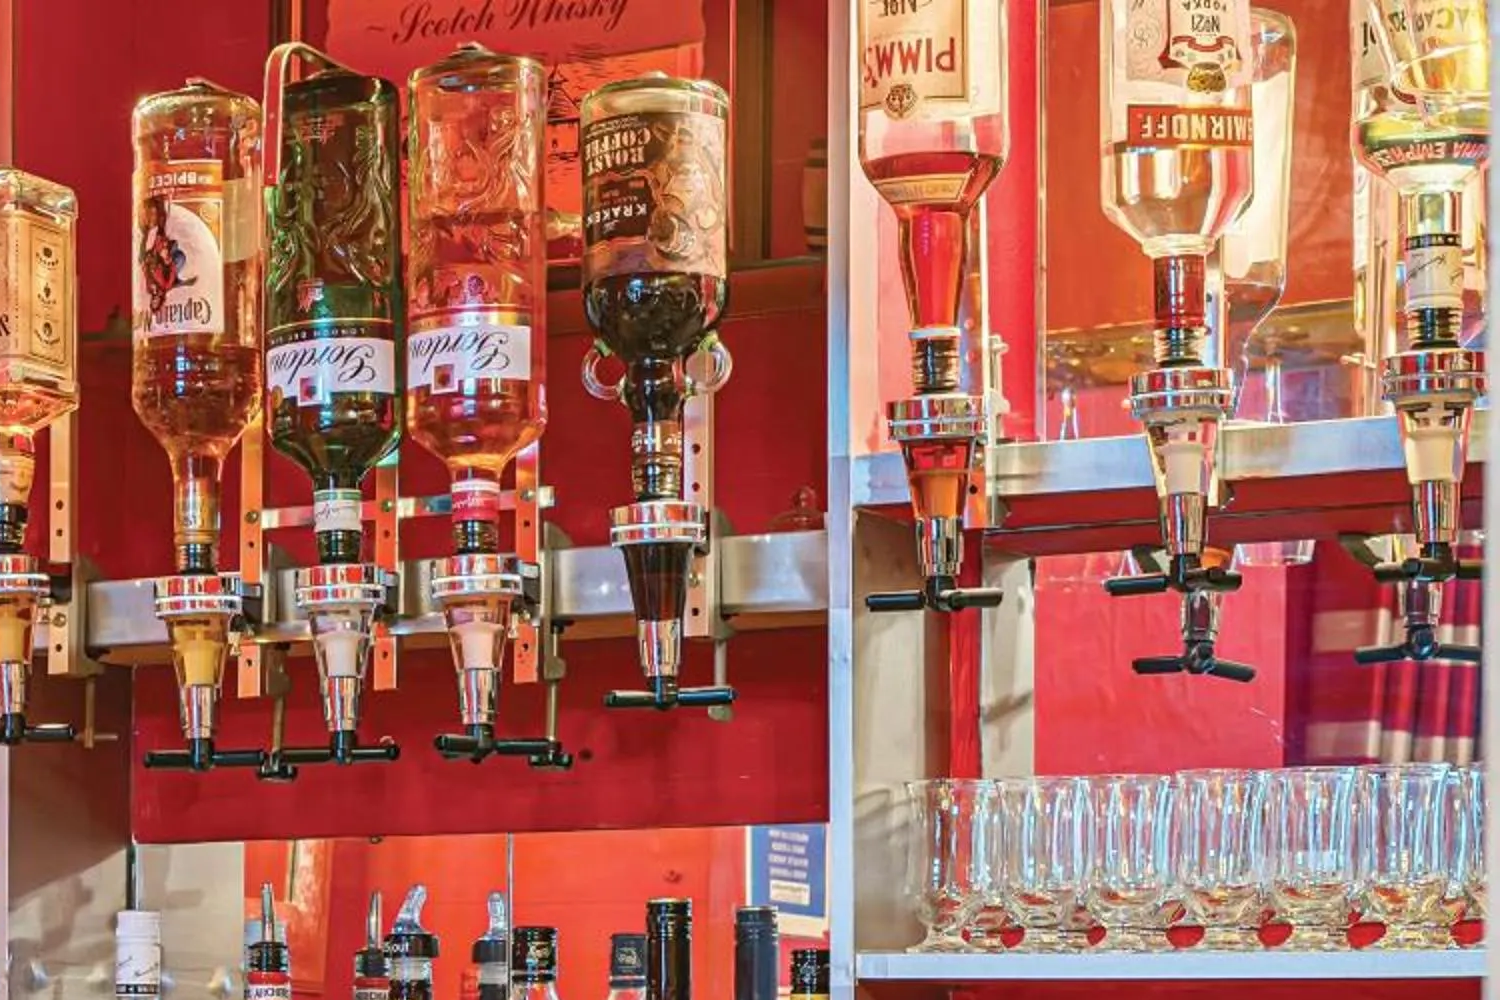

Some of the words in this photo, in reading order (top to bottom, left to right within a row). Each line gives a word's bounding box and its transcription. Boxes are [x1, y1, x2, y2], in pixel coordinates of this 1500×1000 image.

[392, 5, 495, 44] Scotch
[503, 0, 630, 32] Whisky
[863, 36, 955, 88] PIMM'S
[155, 297, 213, 326] Captain
[272, 343, 377, 384] Gordon
[410, 330, 511, 372] Gordon
